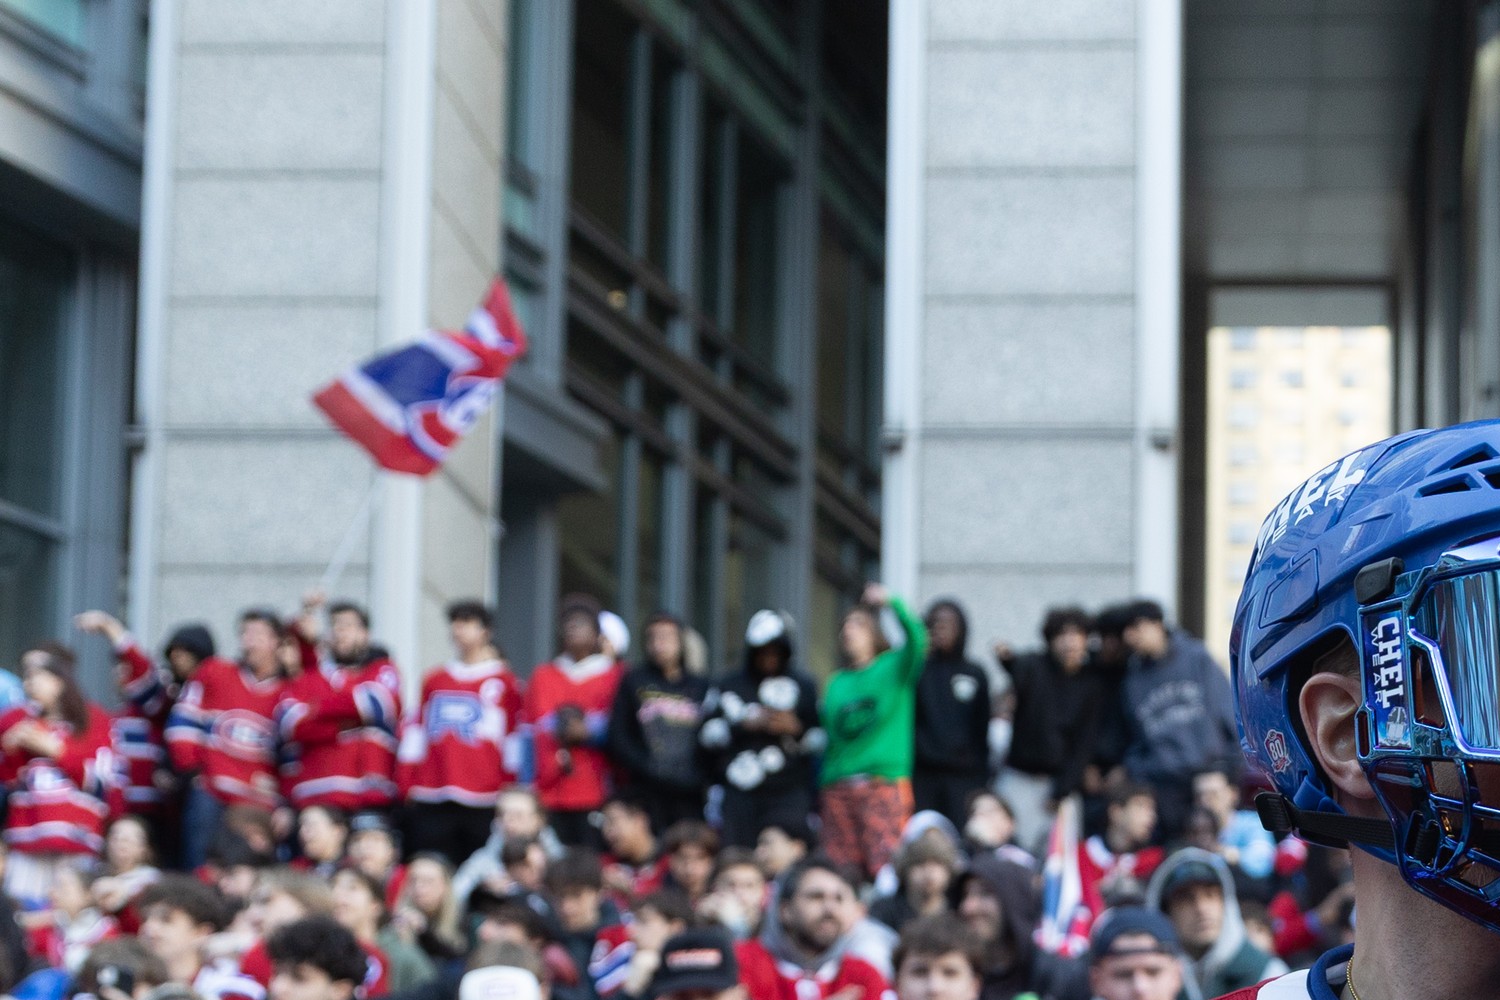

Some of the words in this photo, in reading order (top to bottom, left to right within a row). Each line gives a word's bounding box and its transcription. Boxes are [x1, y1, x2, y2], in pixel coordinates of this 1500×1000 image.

[1370, 626, 1384, 705] WEAR
[1377, 616, 1404, 709] CHEL
[1269, 739, 1284, 761] 80
